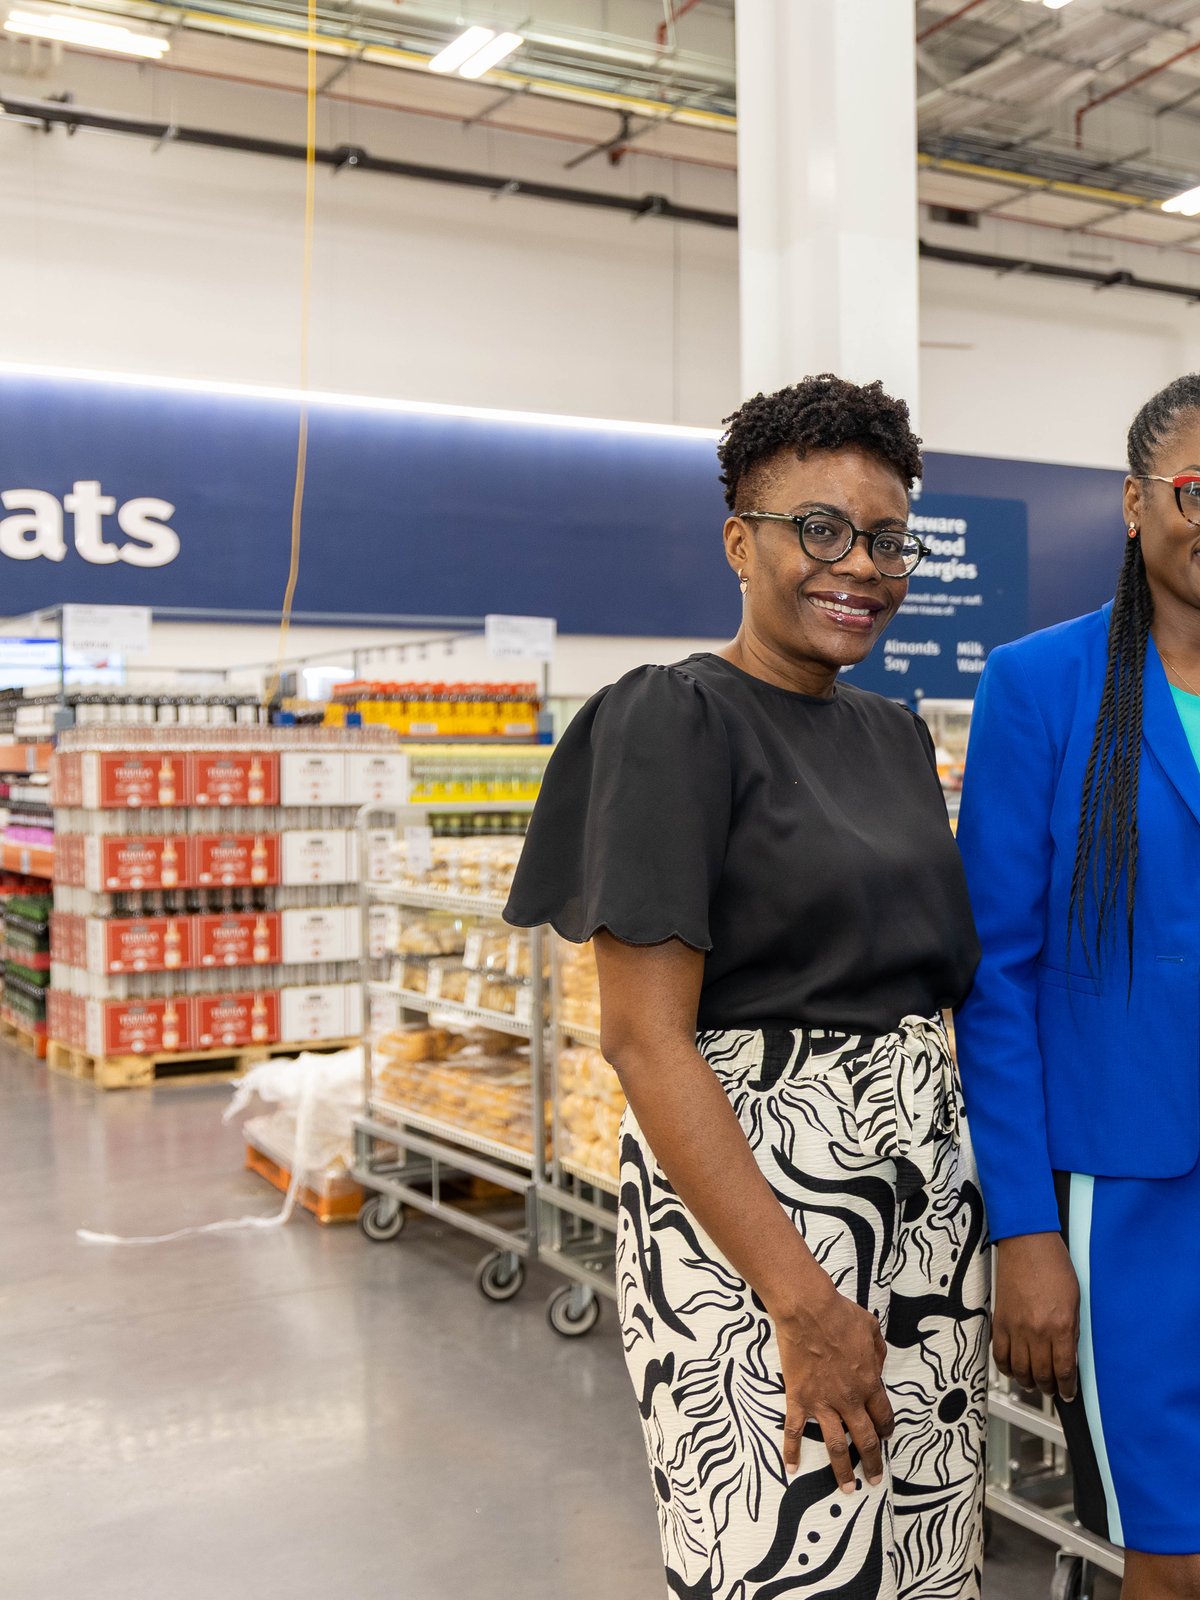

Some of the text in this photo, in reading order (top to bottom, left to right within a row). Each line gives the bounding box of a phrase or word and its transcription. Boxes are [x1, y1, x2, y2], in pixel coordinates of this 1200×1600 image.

[0, 480, 181, 568] ats
[884, 639, 940, 656] Almonds
[957, 641, 984, 657] Milk
[884, 656, 910, 674] Soy
